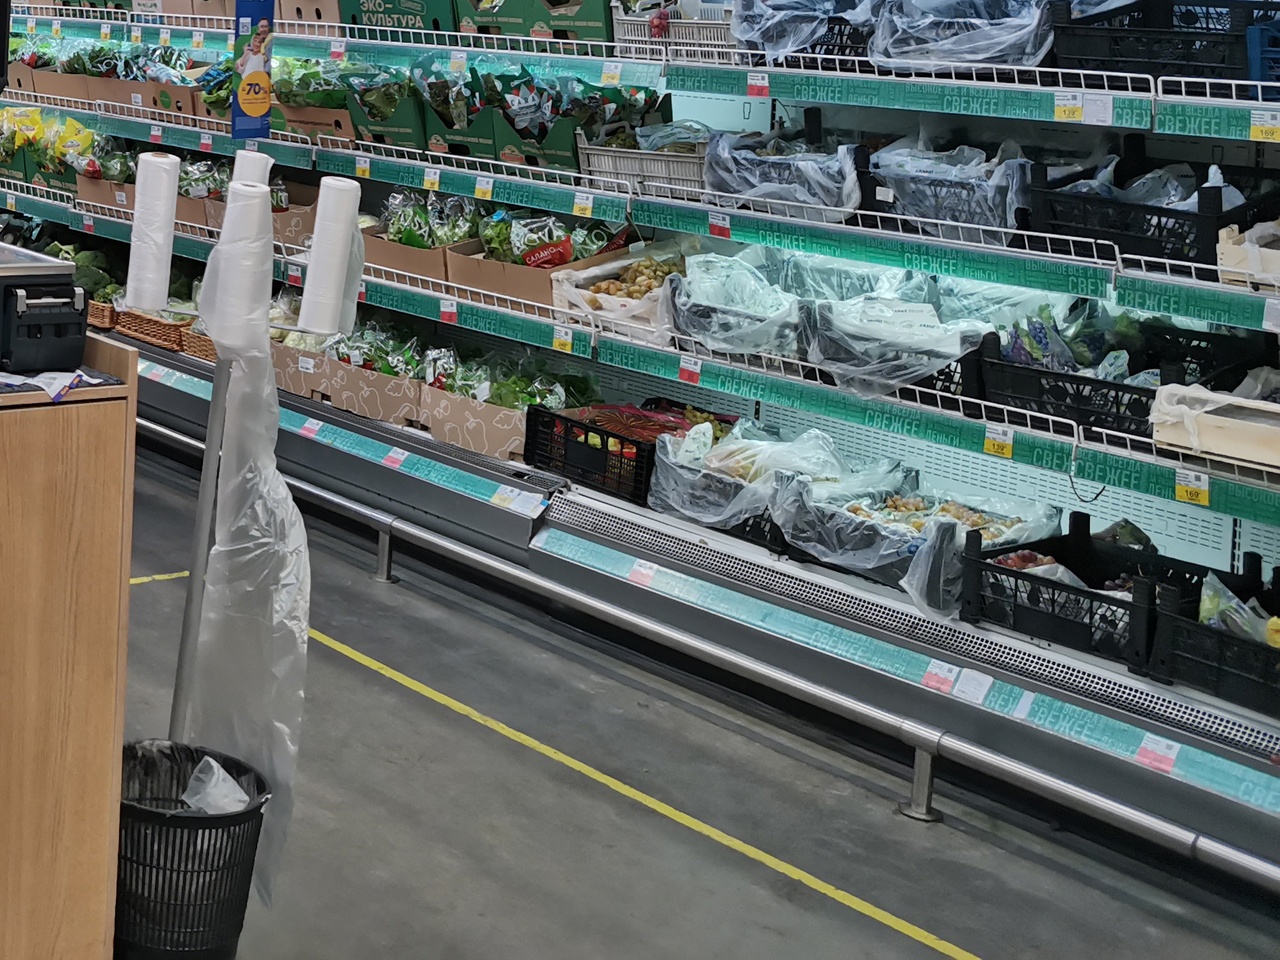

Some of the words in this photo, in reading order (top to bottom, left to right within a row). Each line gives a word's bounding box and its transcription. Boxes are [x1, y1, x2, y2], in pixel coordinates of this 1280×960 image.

[361, 12, 424, 29] КУЛЬТУРА
[793, 85, 842, 103] СВЕЖЕЕ
[848, 93, 879, 106] ДЕНЬГИ
[968, 87, 999, 99] ВСЕГДА
[944, 97, 998, 115] СВЕЖЕЕ
[1005, 105, 1039, 119] ДЕНЬГИ
[1185, 105, 1220, 119] ВСЕГДА
[1230, 108, 1250, 119] КАЧЕ
[1113, 108, 1151, 129] СВЕЖ
[1154, 114, 1220, 137] СВЕЖЕЕ
[1229, 125, 1250, 138] ДЕН
[494, 188, 528, 204] СВЕЖЕЕ
[600, 205, 626, 221] СВЕЖ
[632, 209, 672, 228] СВЕЖЕЕ
[759, 230, 806, 252] СВЕЖЕЕ
[928, 245, 958, 260] ВСЕГДА
[904, 252, 957, 275] СВЕЖЕЕ
[1025, 258, 1069, 275] ВЫСОКОЕ
[1070, 266, 1085, 277] ВСЕ
[1069, 275, 1107, 297] СВЕЖ
[1145, 280, 1180, 297] ВСЕГДА
[1116, 288, 1180, 315] СВЕЖЕЕ
[1188, 304, 1230, 323] ДЕНЬГИ
[717, 375, 765, 399] СВЕЖЕЕ
[865, 410, 920, 437] СВЕЖЕЕ
[926, 429, 962, 447] ДЕНЬГИ
[991, 442, 1007, 451] 139
[1032, 448, 1070, 472] СВЕЖ
[1107, 453, 1141, 472] ВСЕГДА
[1073, 459, 1141, 490] СВЕЖЕЕ
[1148, 482, 1176, 500] ДЕНЬ
[1184, 488, 1200, 500] 169
[986, 691, 1018, 716] ВЕЖ
[1027, 704, 1096, 739] СВЕЖЕЕ
[1238, 781, 1280, 809] СВЕ
